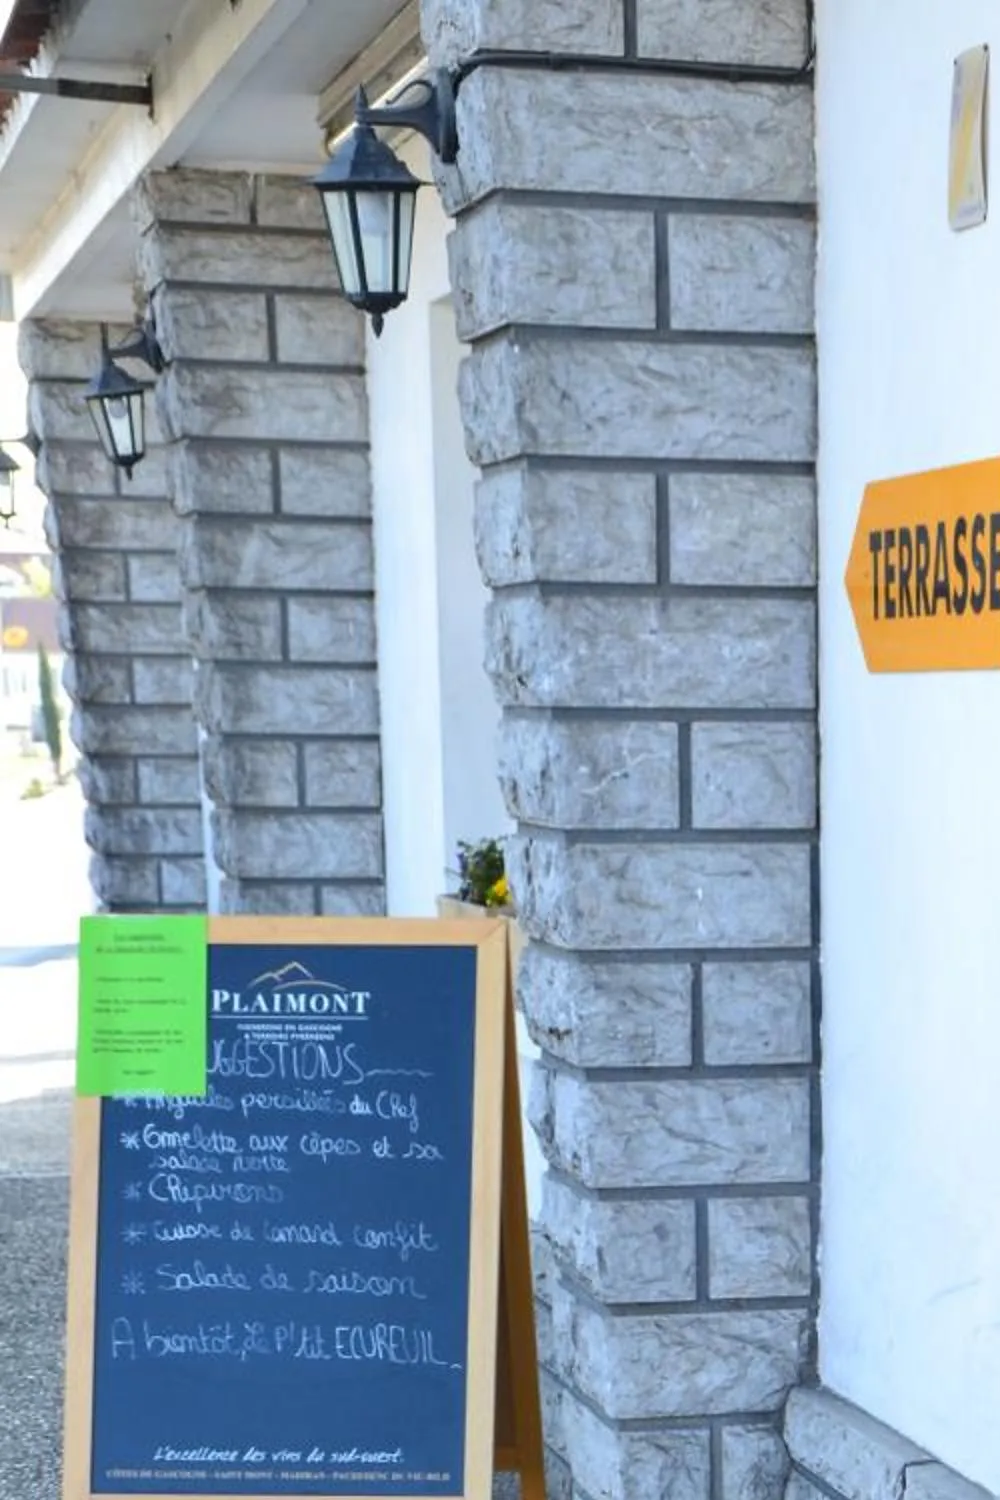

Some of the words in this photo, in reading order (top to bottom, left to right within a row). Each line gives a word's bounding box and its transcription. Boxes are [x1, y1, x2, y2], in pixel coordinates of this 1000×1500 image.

[211, 988, 371, 1014] PLAIMONT
[249, 1135, 289, 1152] aux
[372, 1135, 396, 1158] et
[229, 1219, 254, 1241] de
[156, 1259, 252, 1292] Salade
[259, 1263, 294, 1292] de
[153, 1445, 240, 1462] L'excellence
[242, 1446, 266, 1463] des
[306, 1447, 326, 1464] du
